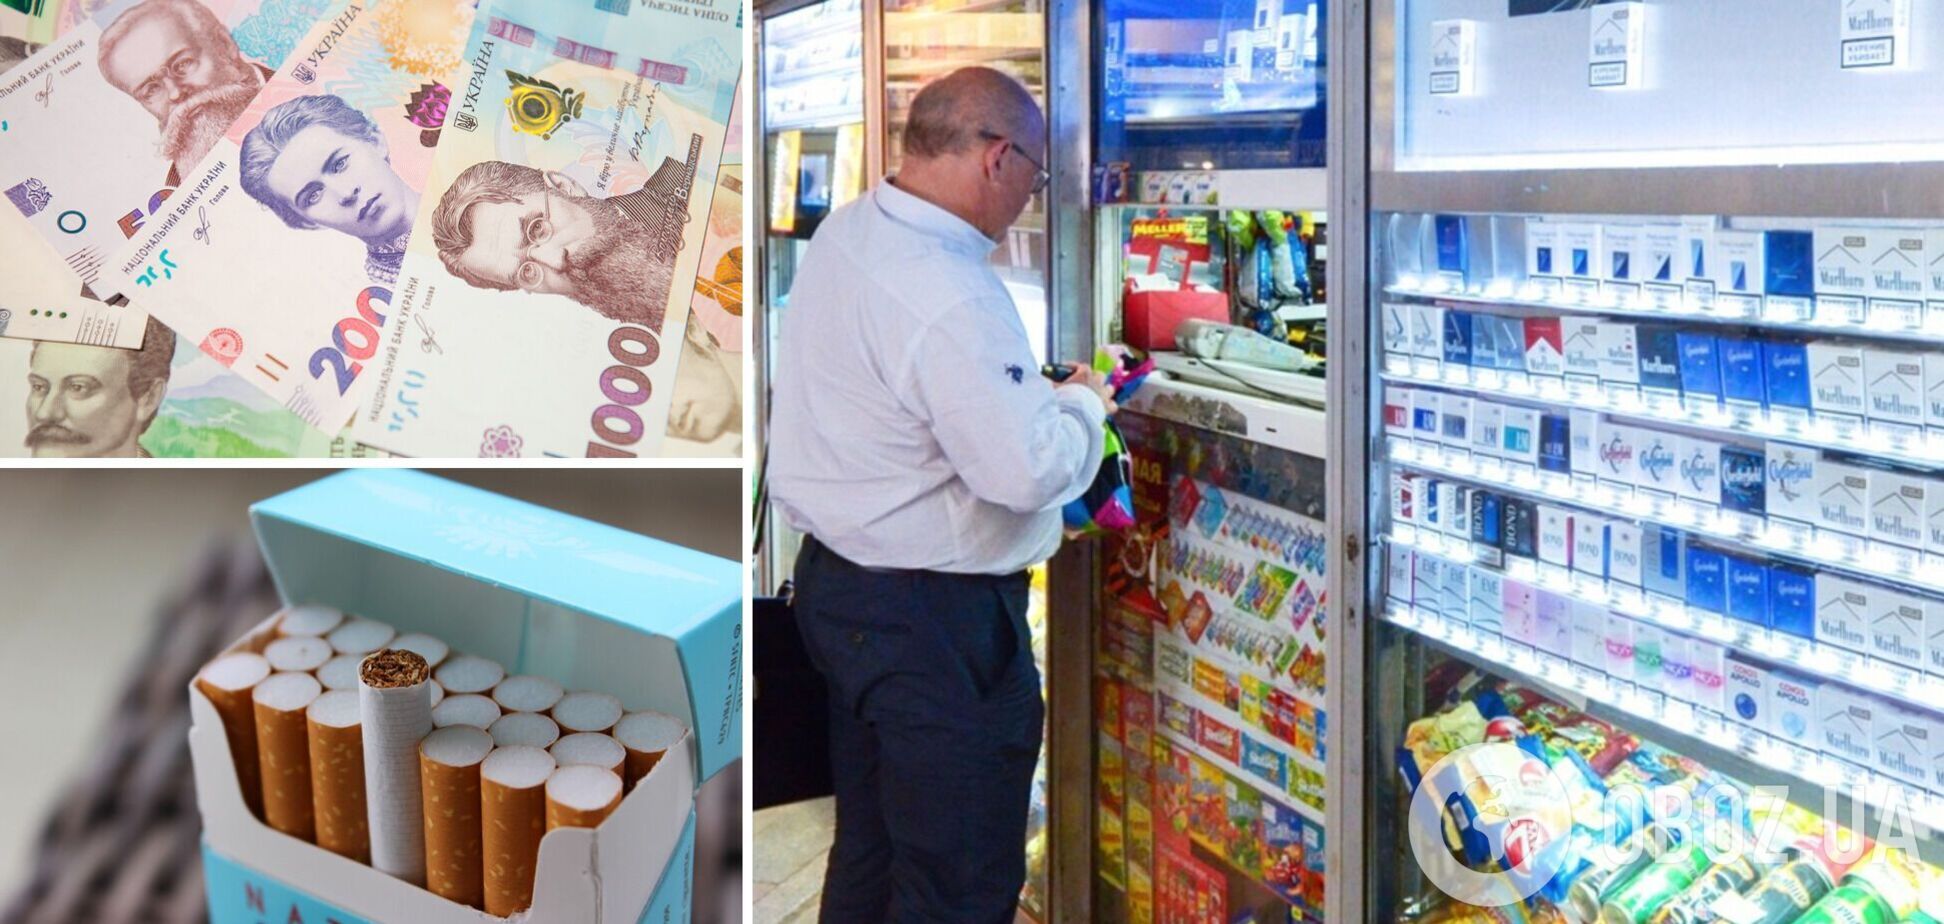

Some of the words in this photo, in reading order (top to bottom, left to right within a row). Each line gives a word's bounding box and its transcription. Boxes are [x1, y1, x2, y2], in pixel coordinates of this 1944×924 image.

[1848, 9, 1894, 30] Marlboro
[308, 4, 362, 67] УКРАЇНА
[28, 62, 51, 80] БАНК
[50, 39, 85, 65] УКРАЇНИ
[463, 41, 494, 112] УКРАЇНА
[208, 184, 230, 206] Голова
[121, 213, 181, 275] НАЦІОНАЛЬНИЙ
[176, 192, 199, 216] БАНК
[194, 160, 227, 196] УКРАЇНИ
[1820, 267, 1864, 288] Marlboro
[1875, 270, 1922, 291] Marlboro
[369, 346, 398, 422] НАЦІОНАЛЬНИЙ
[391, 319, 407, 344] БАНК
[400, 276, 419, 318] УКРАЇНИ
[1817, 386, 1862, 406] Marlboro
[1873, 394, 1919, 416] Marlboro
[1506, 504, 1517, 547] BOND
[1822, 504, 1864, 528] Marlboro
[1875, 515, 1921, 539] Marlboro
[1422, 558, 1438, 576] EVE
[1481, 577, 1499, 596] EVE
[1821, 620, 1864, 644] Marlboro
[1874, 634, 1920, 659] Marlboro
[1731, 671, 1761, 688] APOLLO
[1777, 689, 1810, 707] APOLLO
[1826, 731, 1870, 758] Marlboro
[1880, 752, 1926, 779] Marlboro
